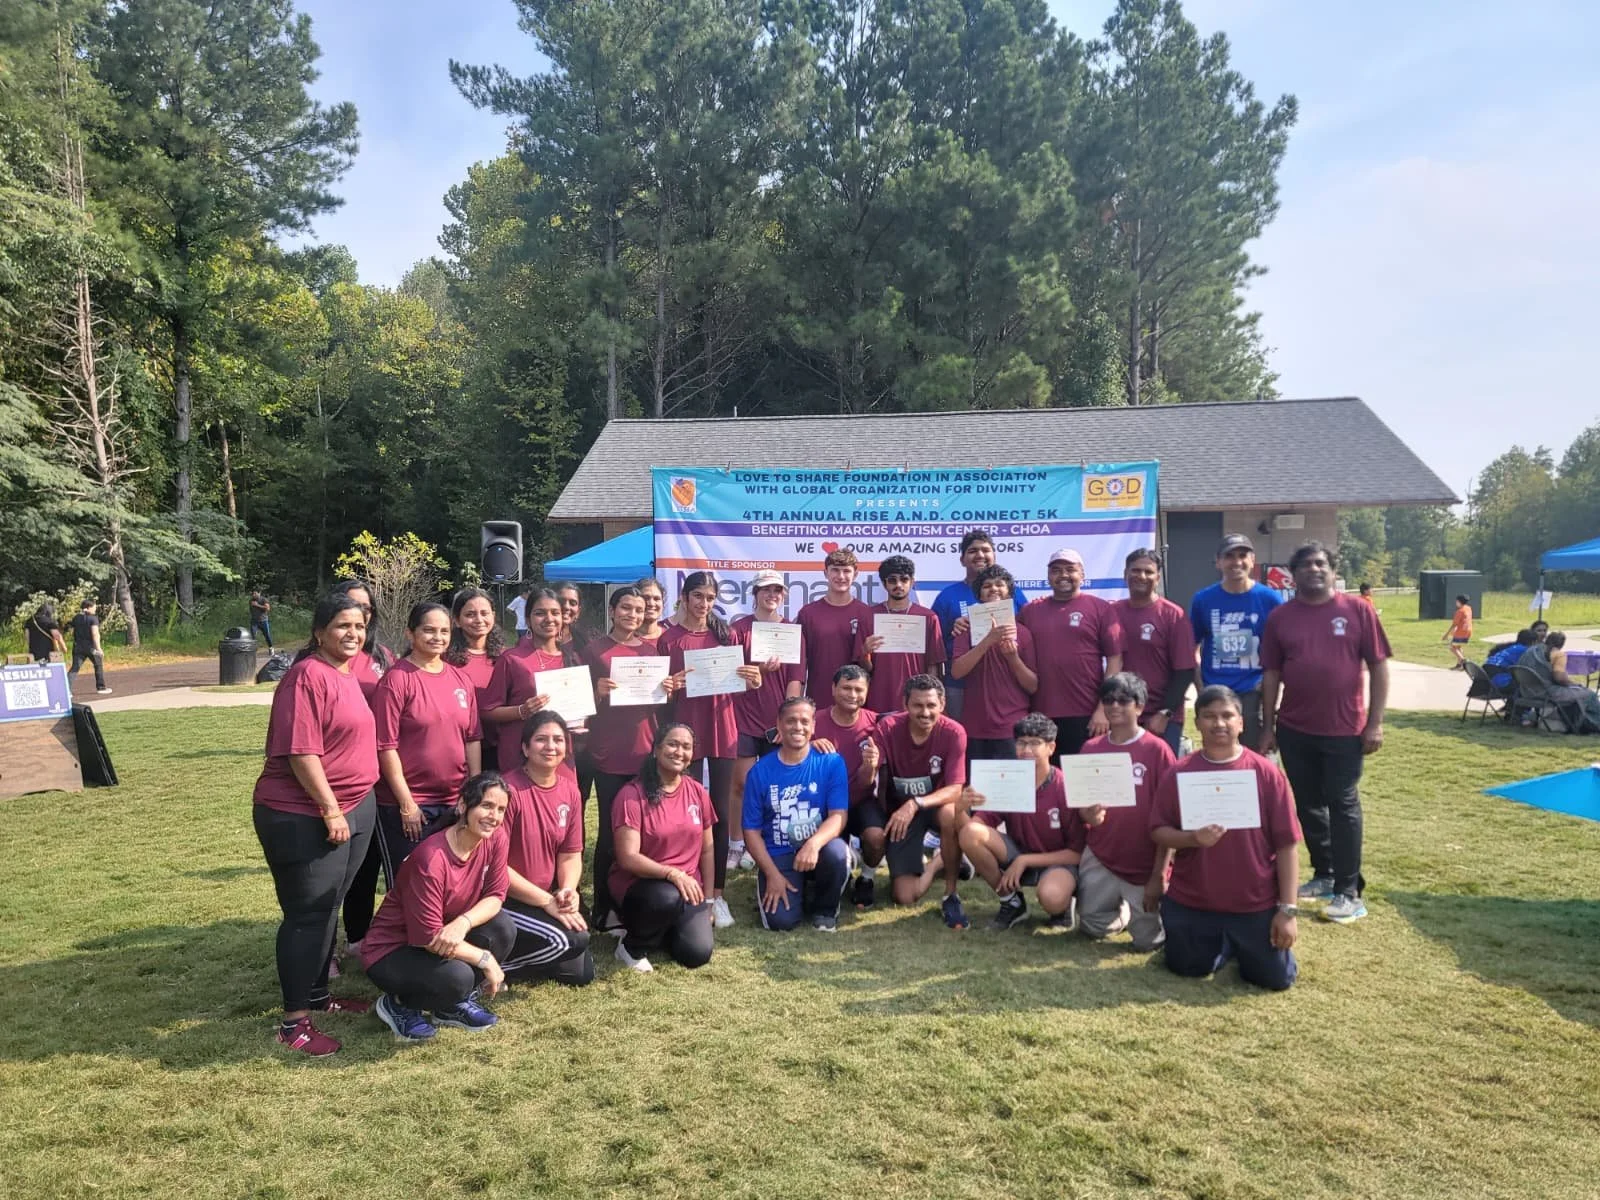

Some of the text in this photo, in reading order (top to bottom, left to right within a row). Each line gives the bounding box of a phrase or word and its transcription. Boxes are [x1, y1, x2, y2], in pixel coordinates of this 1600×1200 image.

[735, 472, 1047, 483] LOVE TO SHARE FOUNDATION IN ASSOCIATION
[745, 484, 1036, 495] WITH GLOBAL ORGANIZATION FOR DIVINITY
[856, 499, 940, 507] PRESENTS
[742, 508, 1058, 521] 4TH ANNUAL RISE A.N.D. CONNECT 5K
[751, 525, 829, 535] BENEFITING
[832, 525, 889, 536] MARCUS
[891, 525, 942, 535] AUTISM
[1010, 524, 1051, 535] CHOA
[795, 542, 815, 554] WE
[846, 543, 874, 553] OUR
[878, 542, 946, 554] AMAZING
[706, 560, 776, 569] TITLE SPONSOR
[1222, 635, 1247, 653] 632
[901, 781, 927, 796] 789
